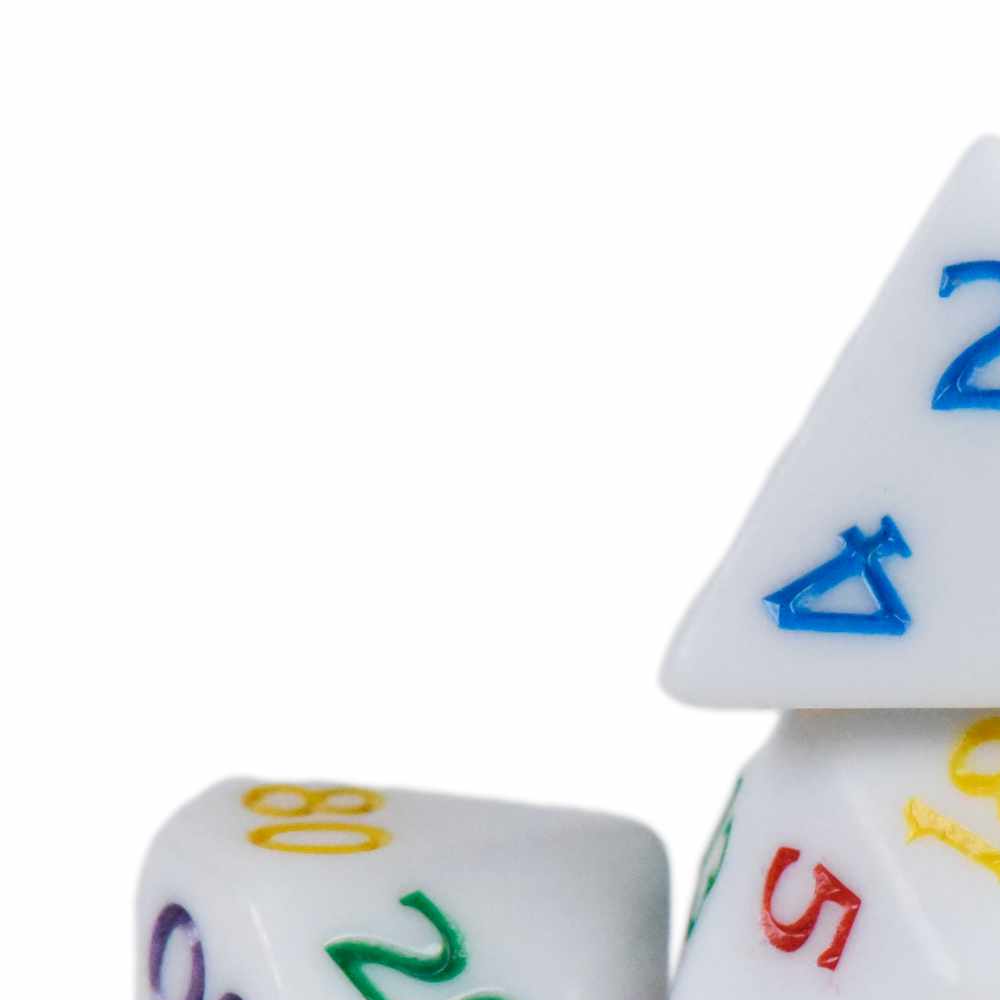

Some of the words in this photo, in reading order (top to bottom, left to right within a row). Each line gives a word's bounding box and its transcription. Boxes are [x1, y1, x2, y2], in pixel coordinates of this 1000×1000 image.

[761, 514, 913, 638] 4
[240, 783, 394, 856] 80
[760, 845, 863, 973] 5
